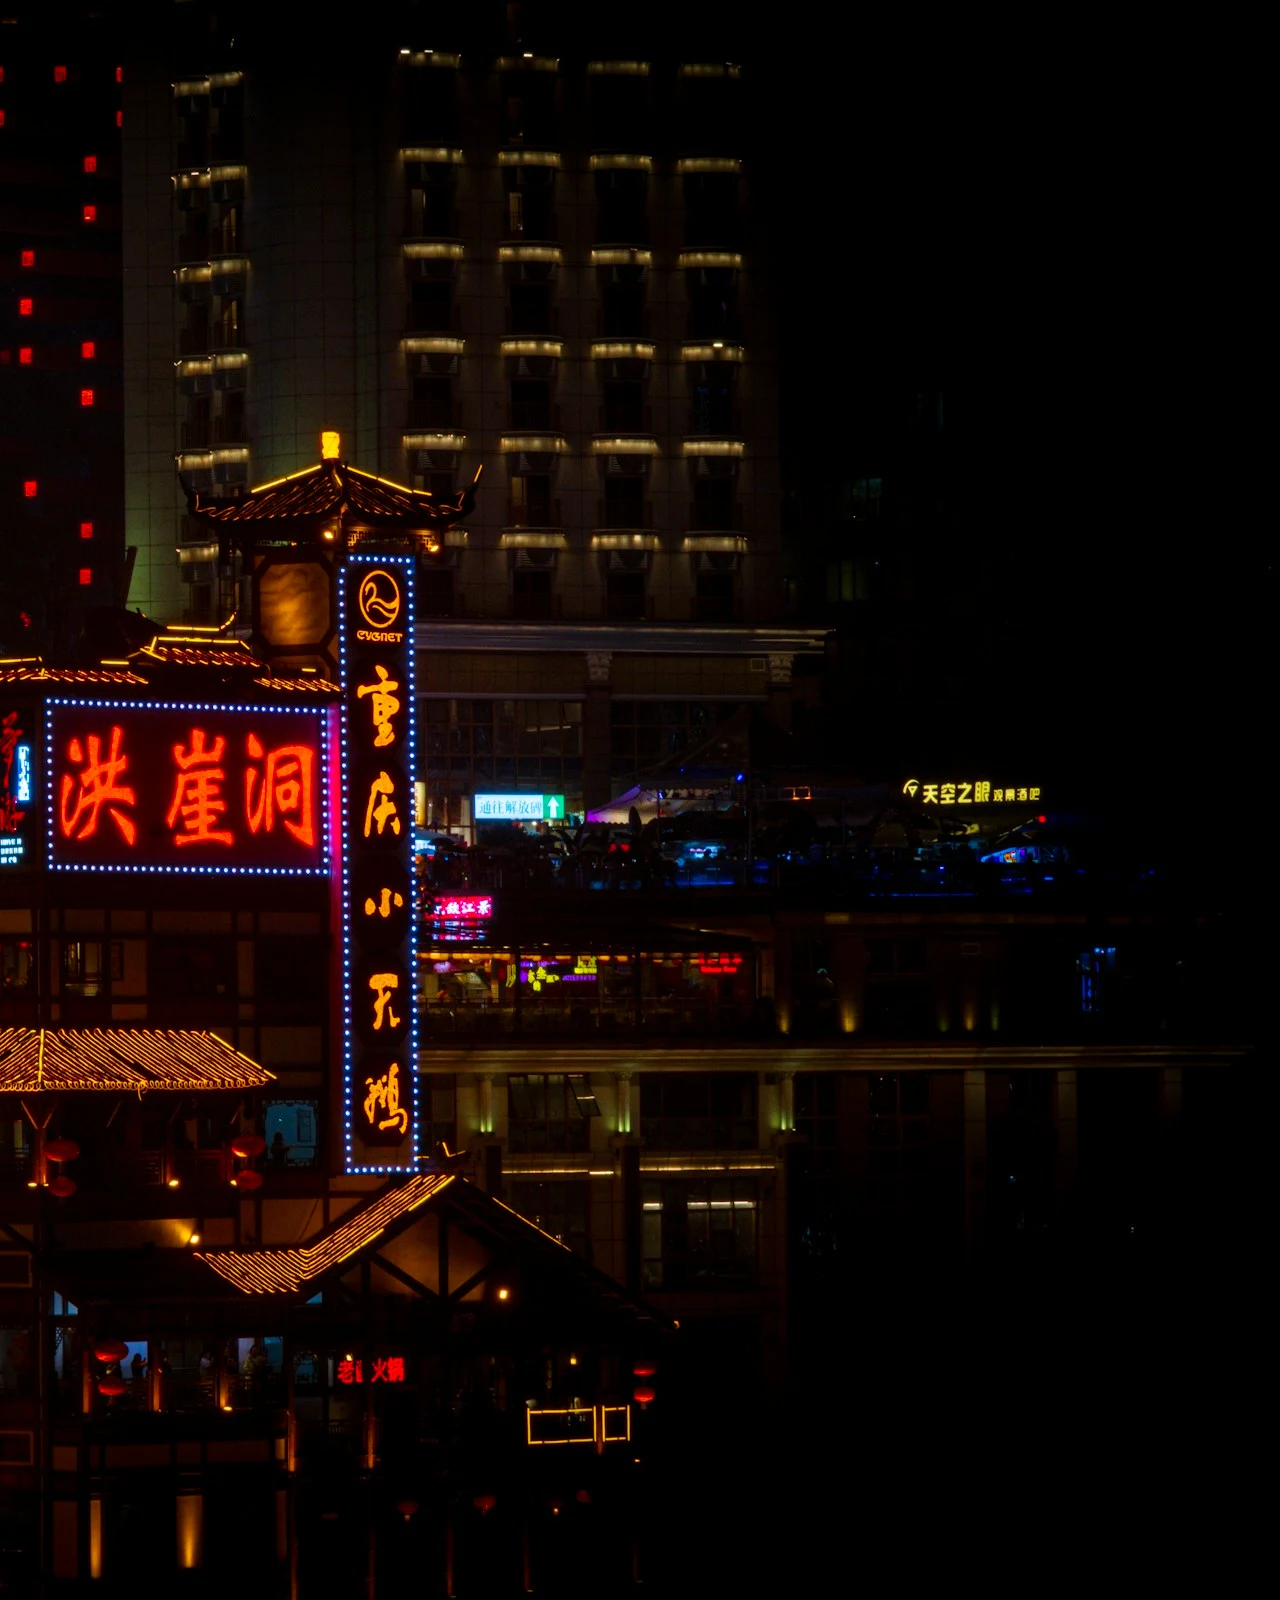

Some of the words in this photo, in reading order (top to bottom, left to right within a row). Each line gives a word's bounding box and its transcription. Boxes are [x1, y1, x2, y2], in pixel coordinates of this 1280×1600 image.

[357, 631, 402, 643] CYGNET
[60, 726, 315, 848] 洪崖洞
[923, 781, 990, 804] 天空之眼
[993, 788, 1040, 801] 观景酒吧
[480, 800, 542, 814] 通往解放碑
